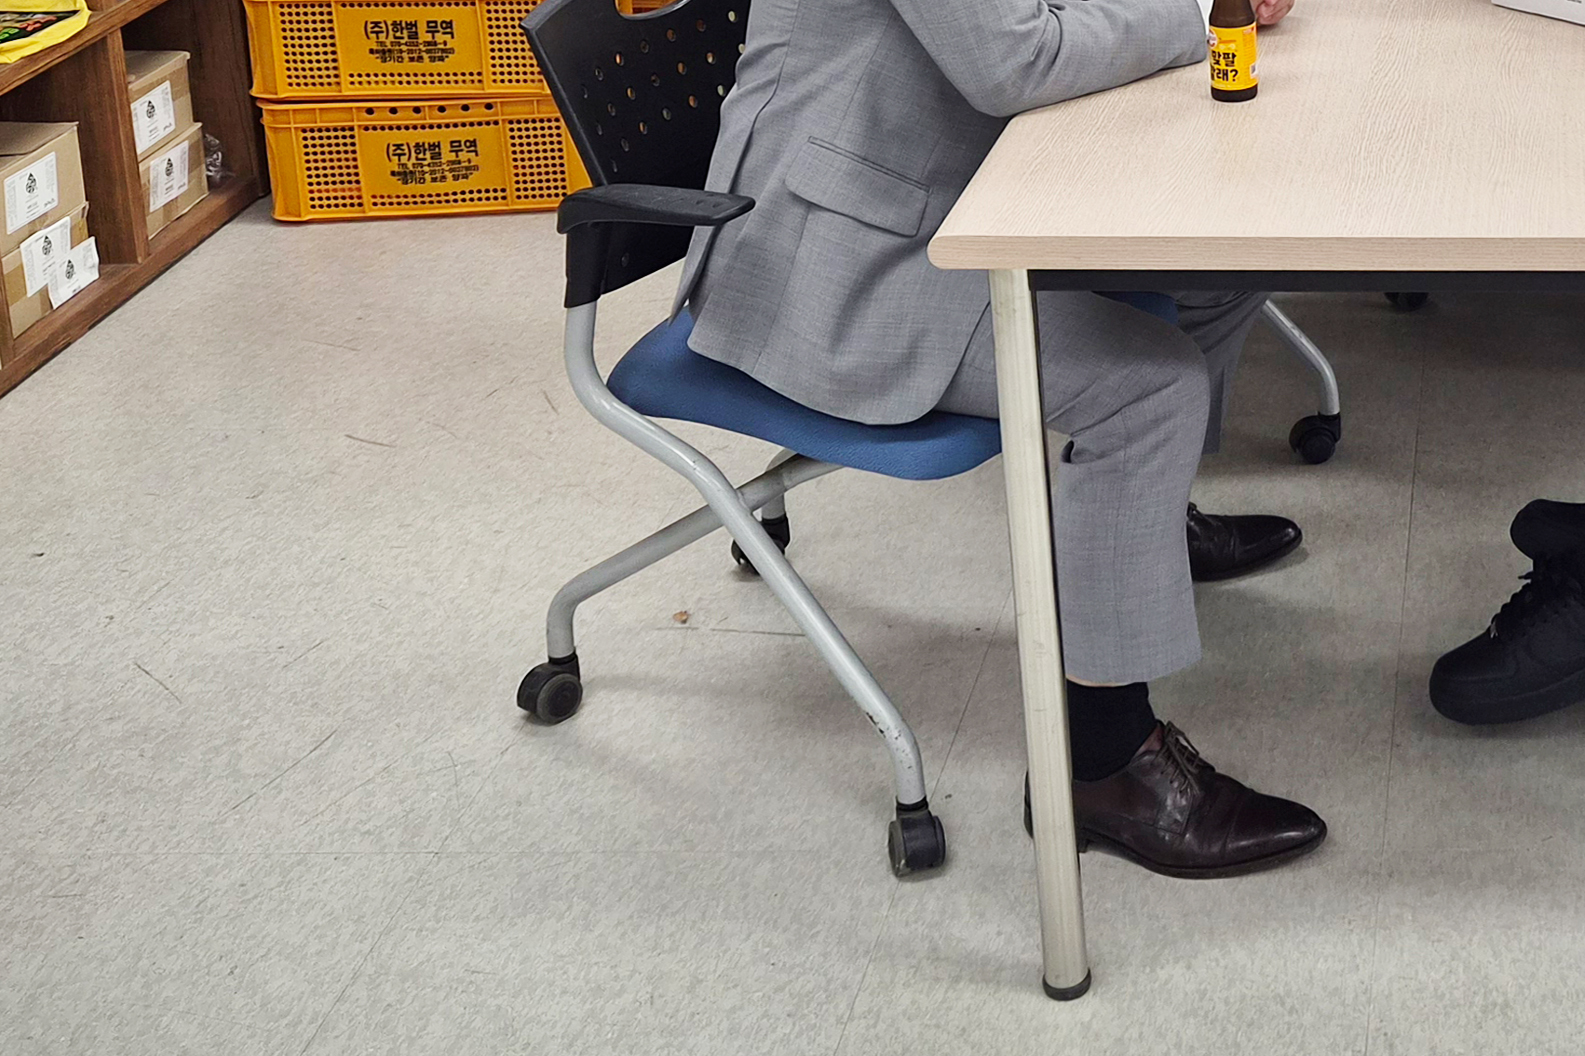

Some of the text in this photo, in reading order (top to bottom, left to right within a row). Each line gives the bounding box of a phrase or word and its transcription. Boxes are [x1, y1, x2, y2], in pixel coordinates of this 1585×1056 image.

[364, 19, 455, 40] (주)한벌 무역
[386, 138, 479, 162] (주)한벌 무역
